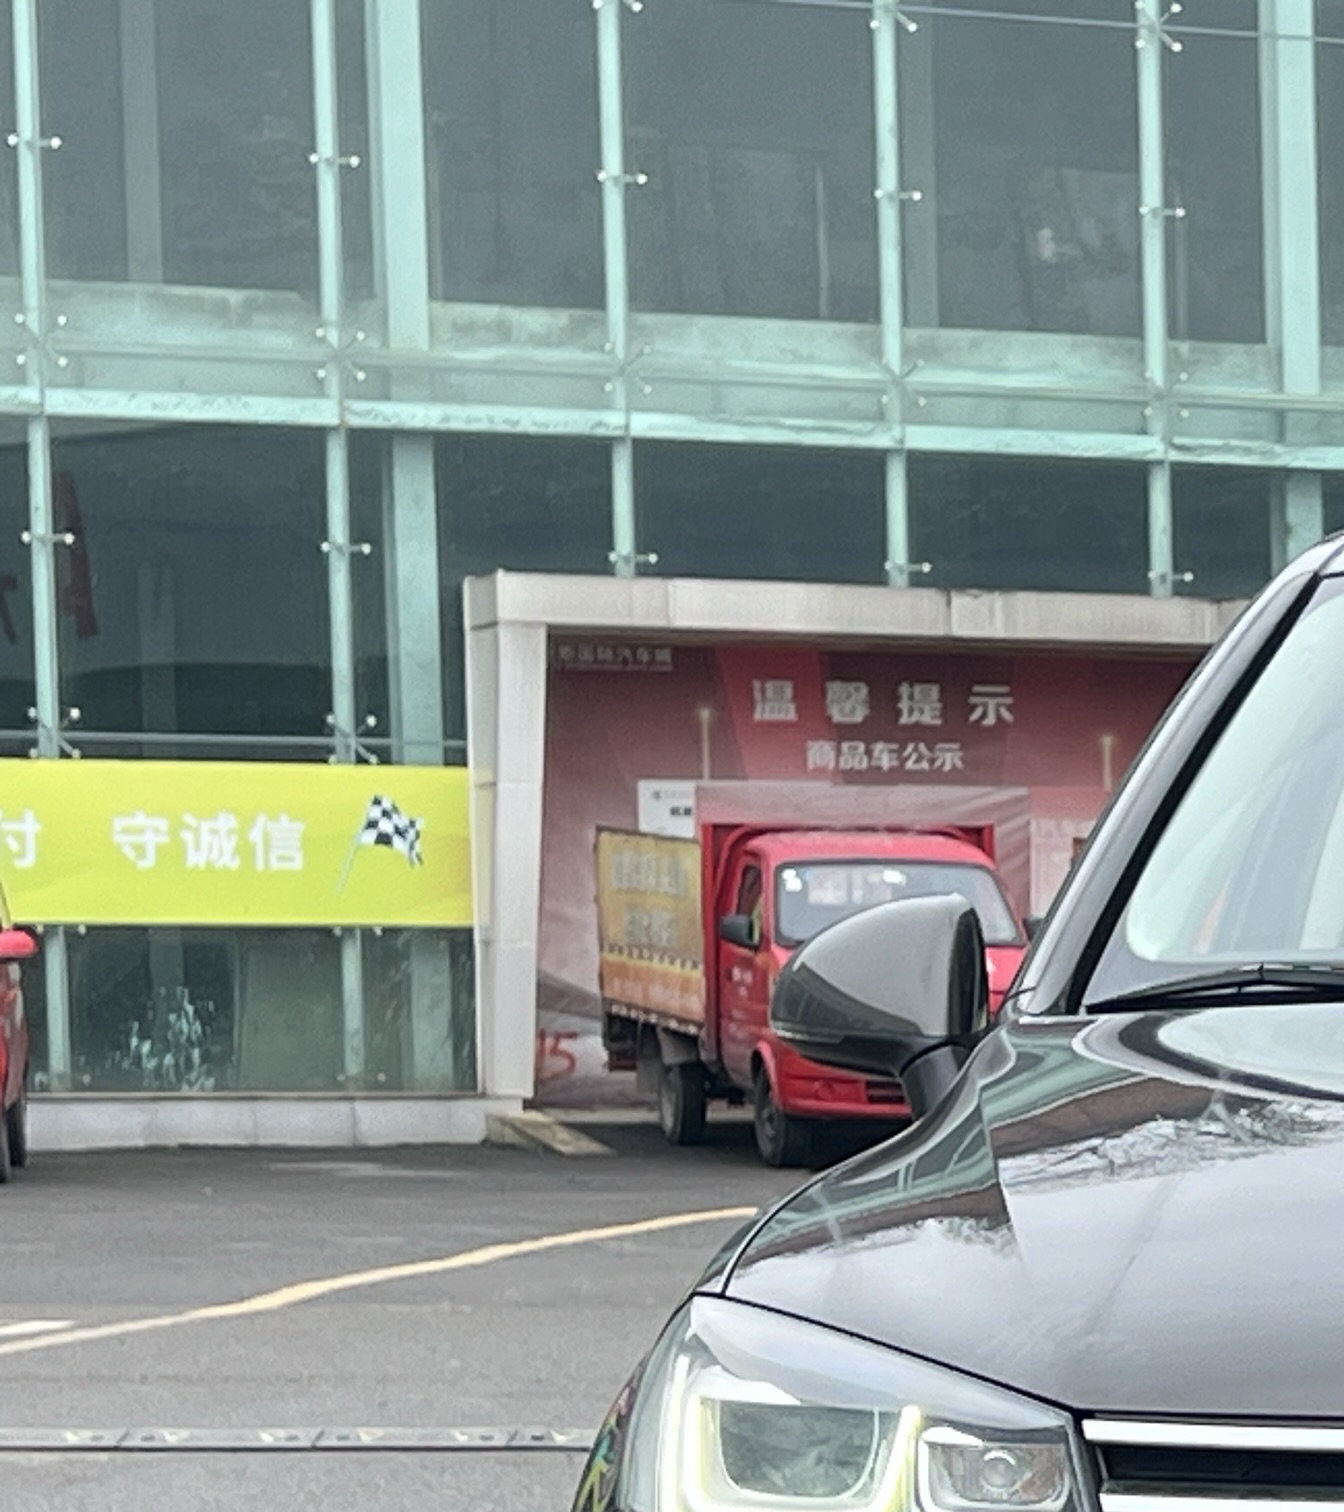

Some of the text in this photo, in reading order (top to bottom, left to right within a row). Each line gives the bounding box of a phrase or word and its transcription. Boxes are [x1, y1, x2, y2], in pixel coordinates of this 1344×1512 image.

[752, 679, 1014, 727] 温馨提示
[806, 740, 964, 772] 商品车公示
[111, 810, 306, 872] 守诚信
